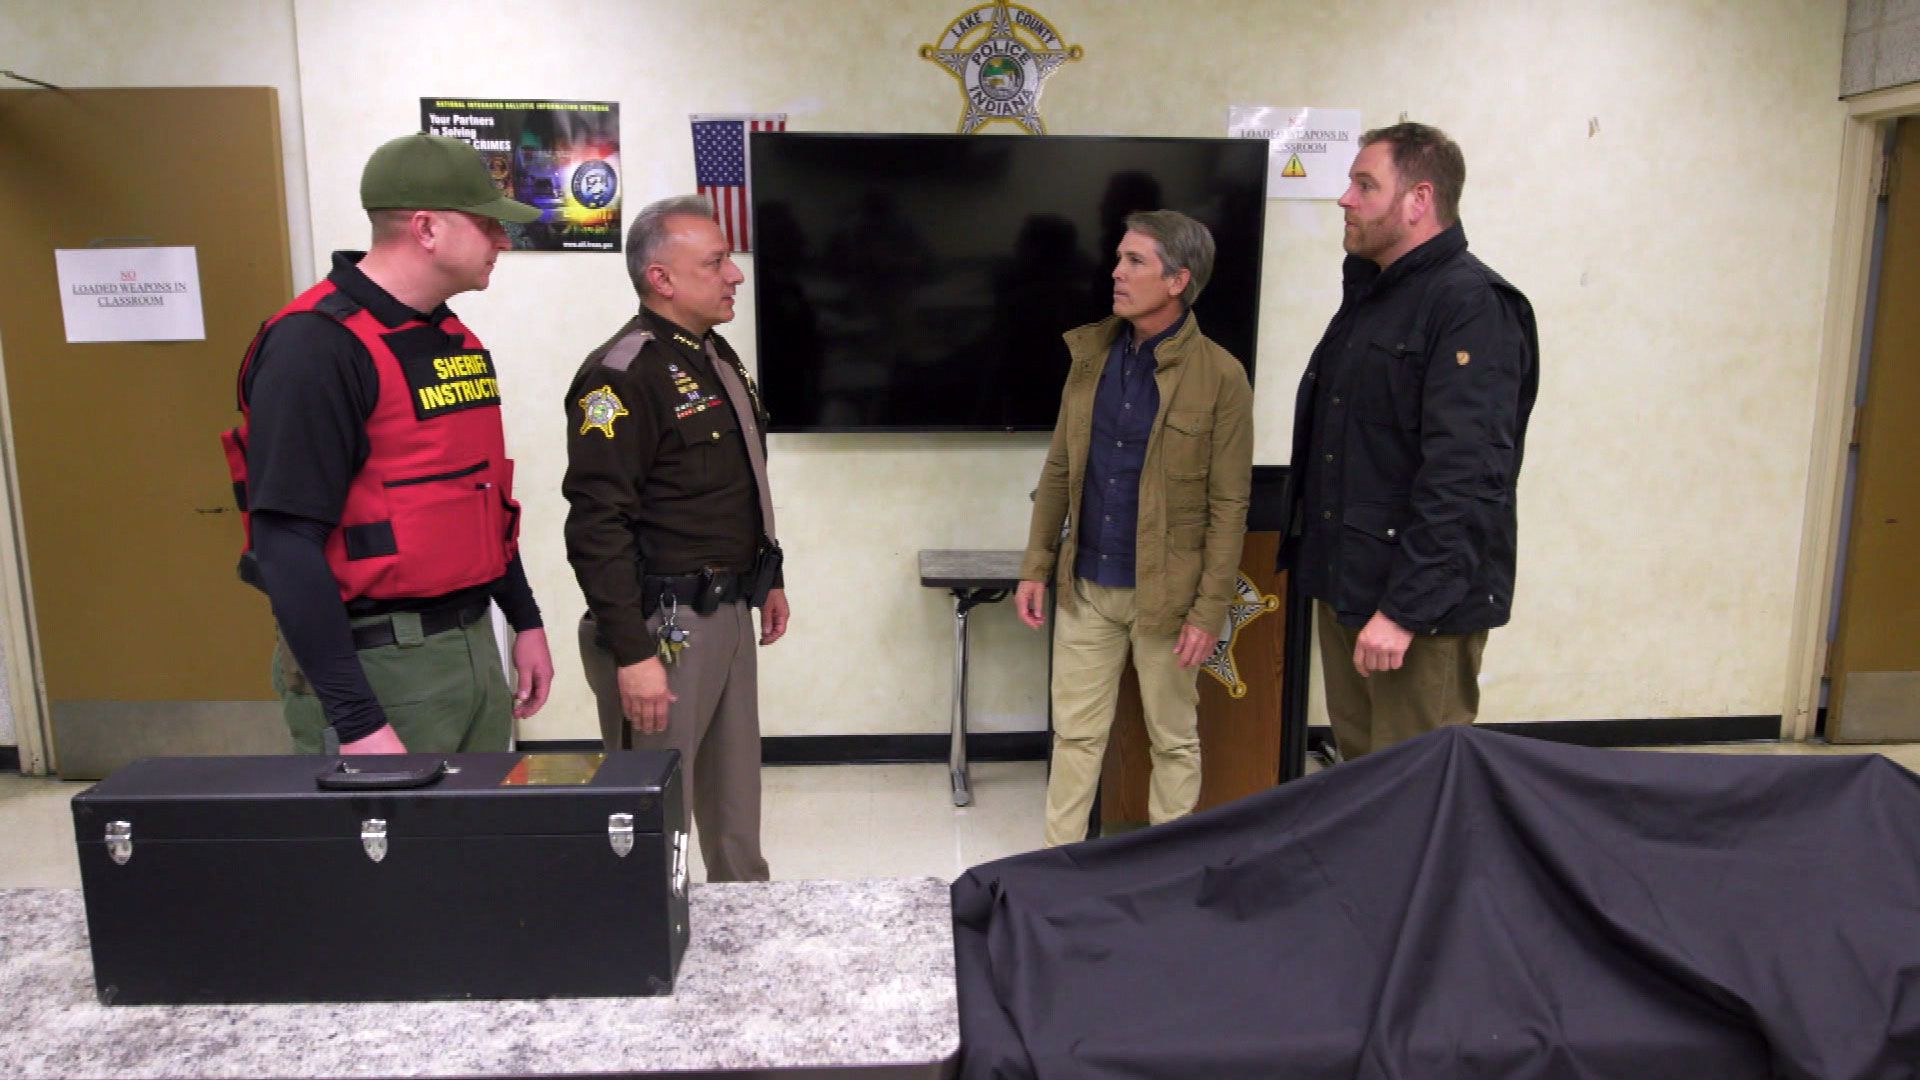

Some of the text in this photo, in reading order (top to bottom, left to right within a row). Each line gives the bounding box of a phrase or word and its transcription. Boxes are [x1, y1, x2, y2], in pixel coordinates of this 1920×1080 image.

[951, 10, 1056, 44] LAKE COUNTY
[971, 40, 1031, 67] POLICE
[969, 86, 1034, 116] INDIANA
[429, 114, 495, 126] Your Partners
[430, 127, 477, 139] in Solving
[1338, 130, 1350, 140] IN
[473, 140, 511, 151] CRIMES
[120, 271, 137, 281] NO
[72, 282, 187, 295] LOADED WEAPONS IN
[97, 296, 164, 307] CLASSROOM
